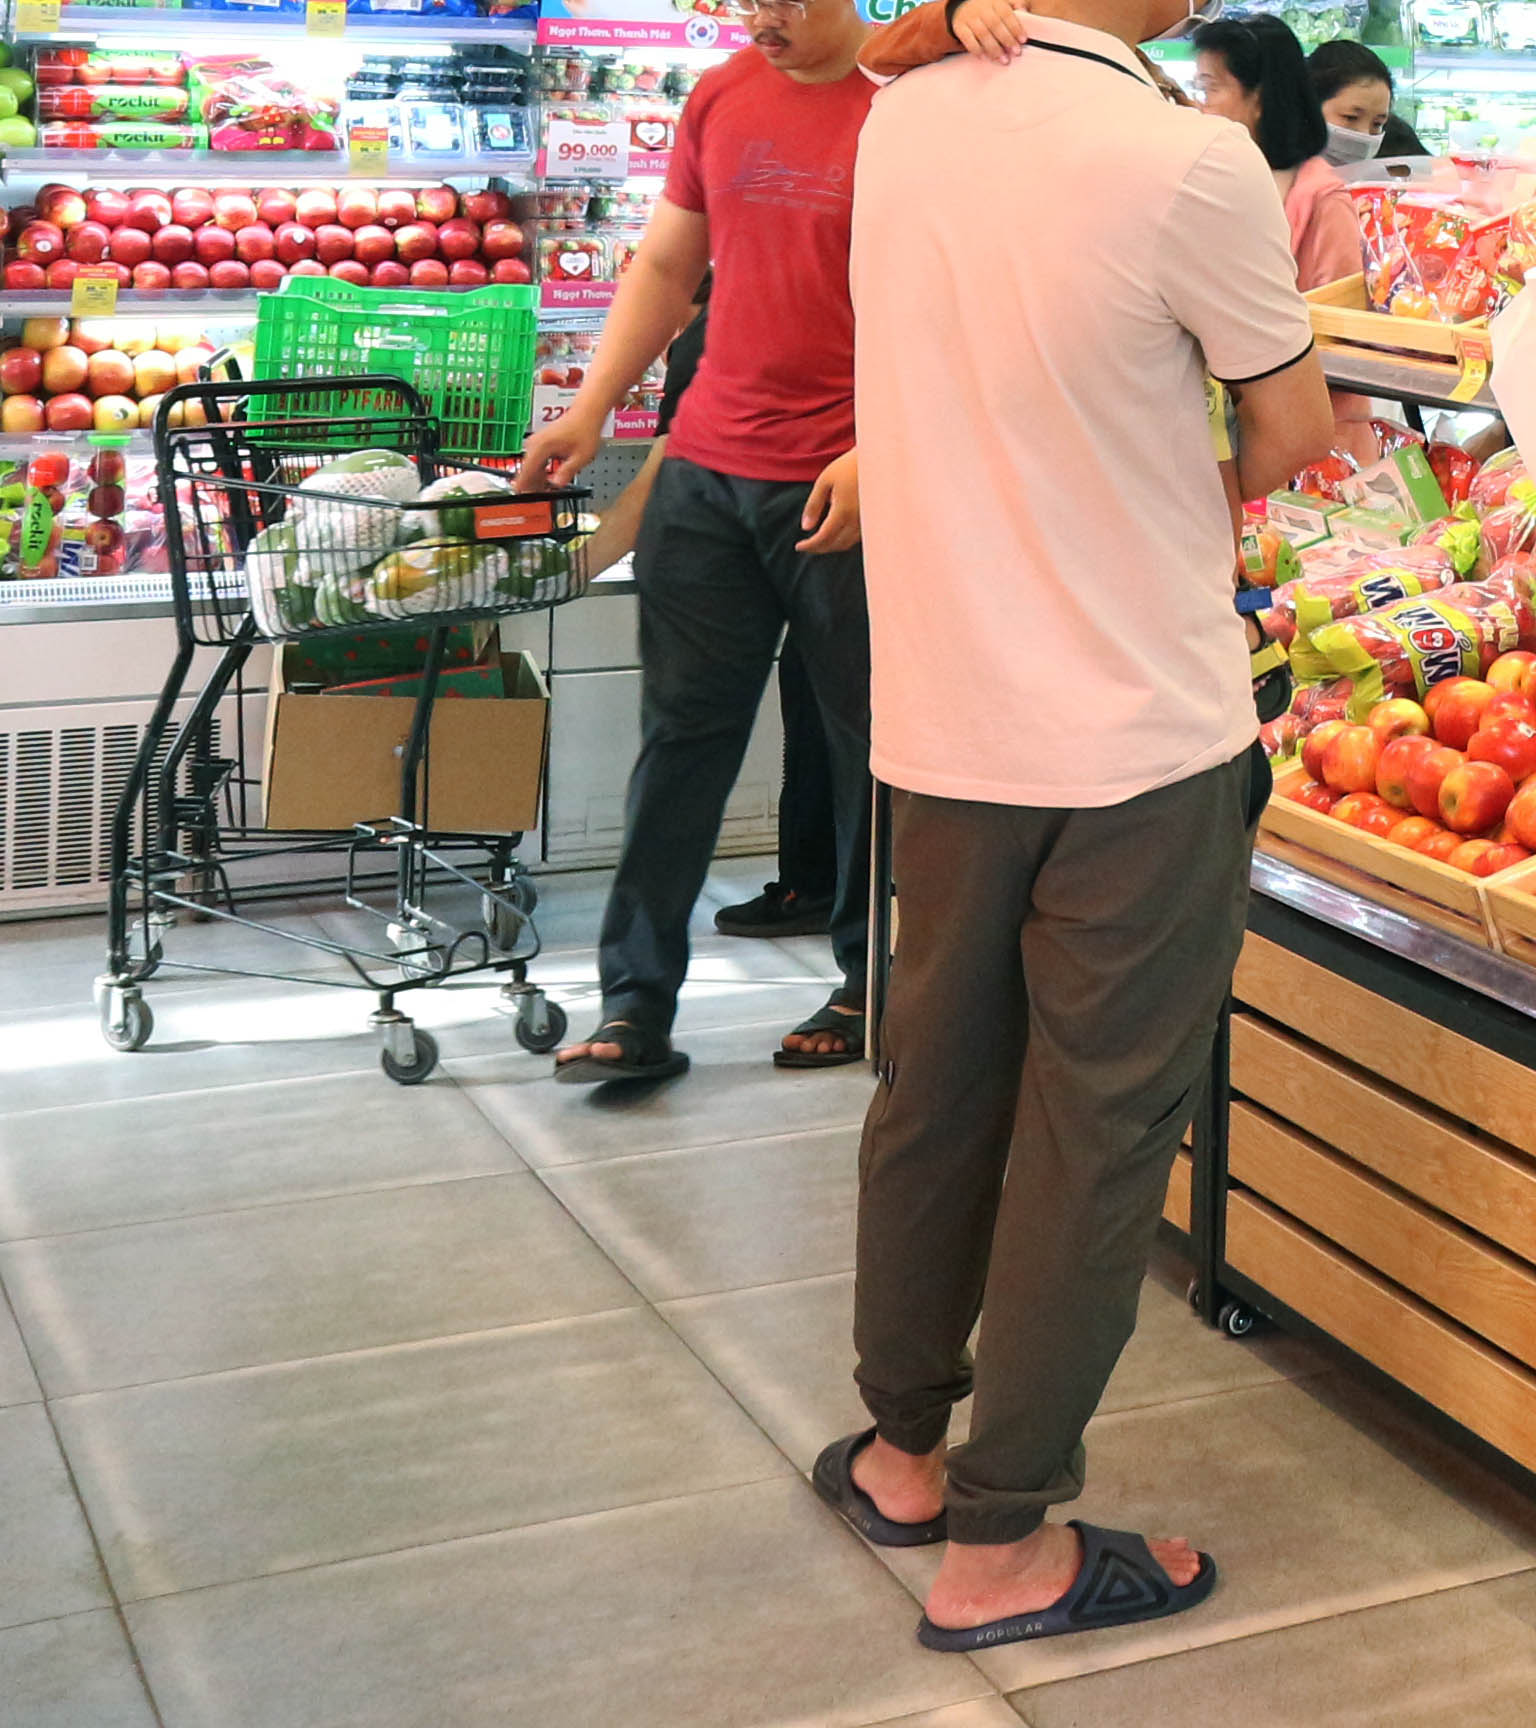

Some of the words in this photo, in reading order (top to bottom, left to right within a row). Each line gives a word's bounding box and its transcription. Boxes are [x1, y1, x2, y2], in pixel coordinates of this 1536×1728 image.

[550, 26, 576, 39] Ngọt
[614, 28, 648, 39] Thanh
[108, 95, 160, 108] rockit
[113, 131, 164, 143] rockit
[558, 143, 618, 161] 99.000
[29, 503, 44, 549] rockit
